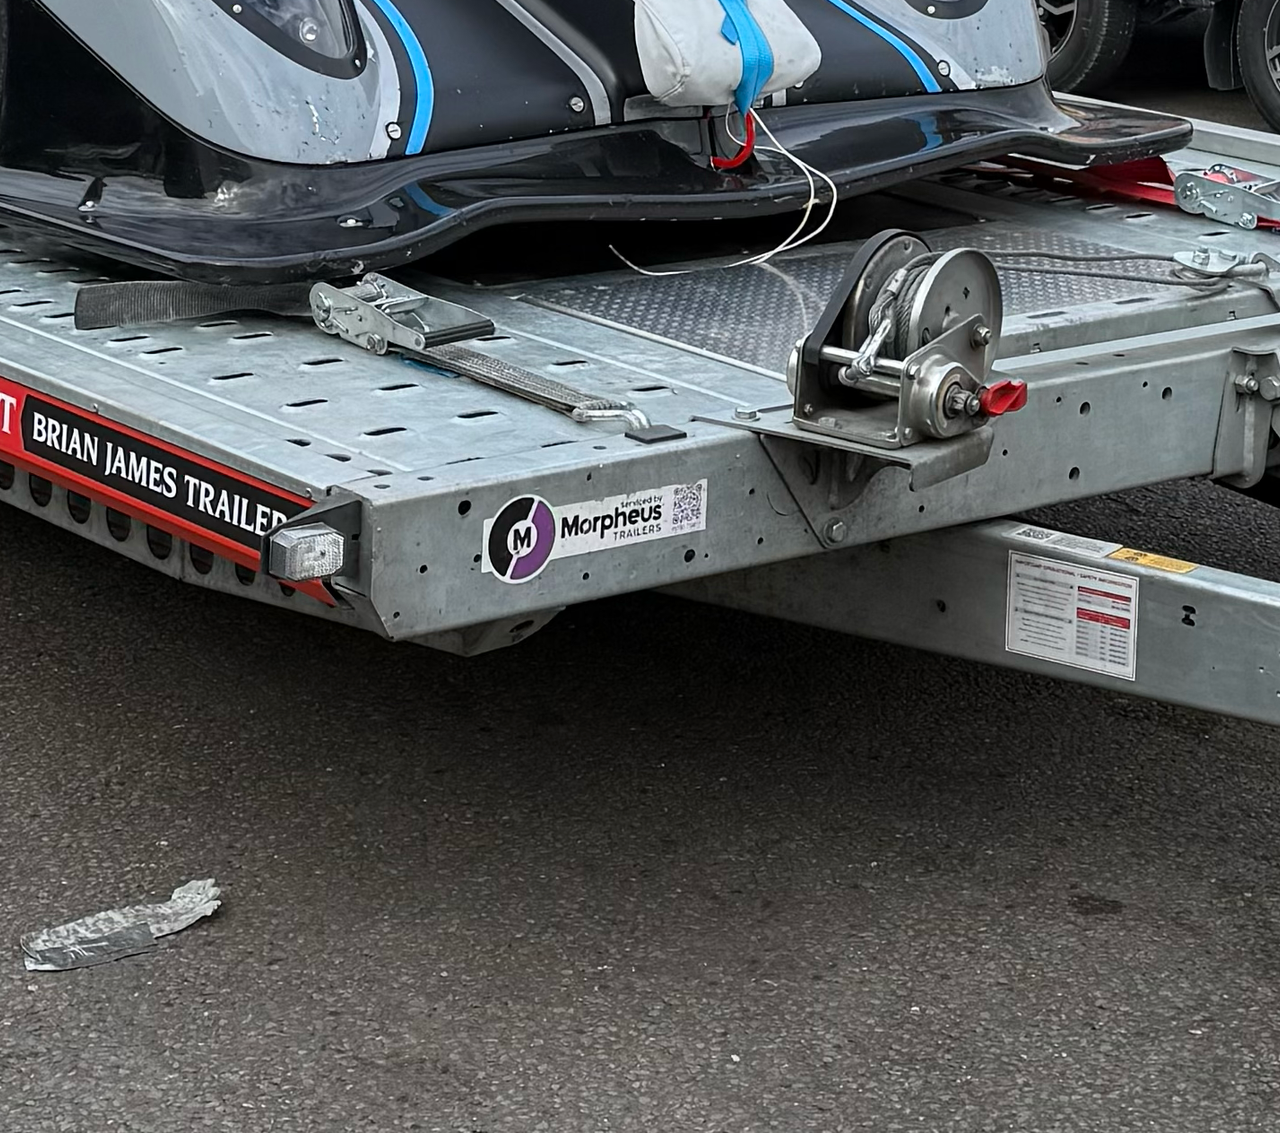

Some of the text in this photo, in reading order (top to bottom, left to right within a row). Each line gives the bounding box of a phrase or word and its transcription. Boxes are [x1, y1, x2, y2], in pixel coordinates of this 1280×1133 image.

[33, 412, 98, 466] BRIAN
[104, 442, 177, 498] JAMES
[561, 505, 662, 538] Morpheus
[613, 523, 661, 541] TRAILERS
[513, 526, 531, 550] M
